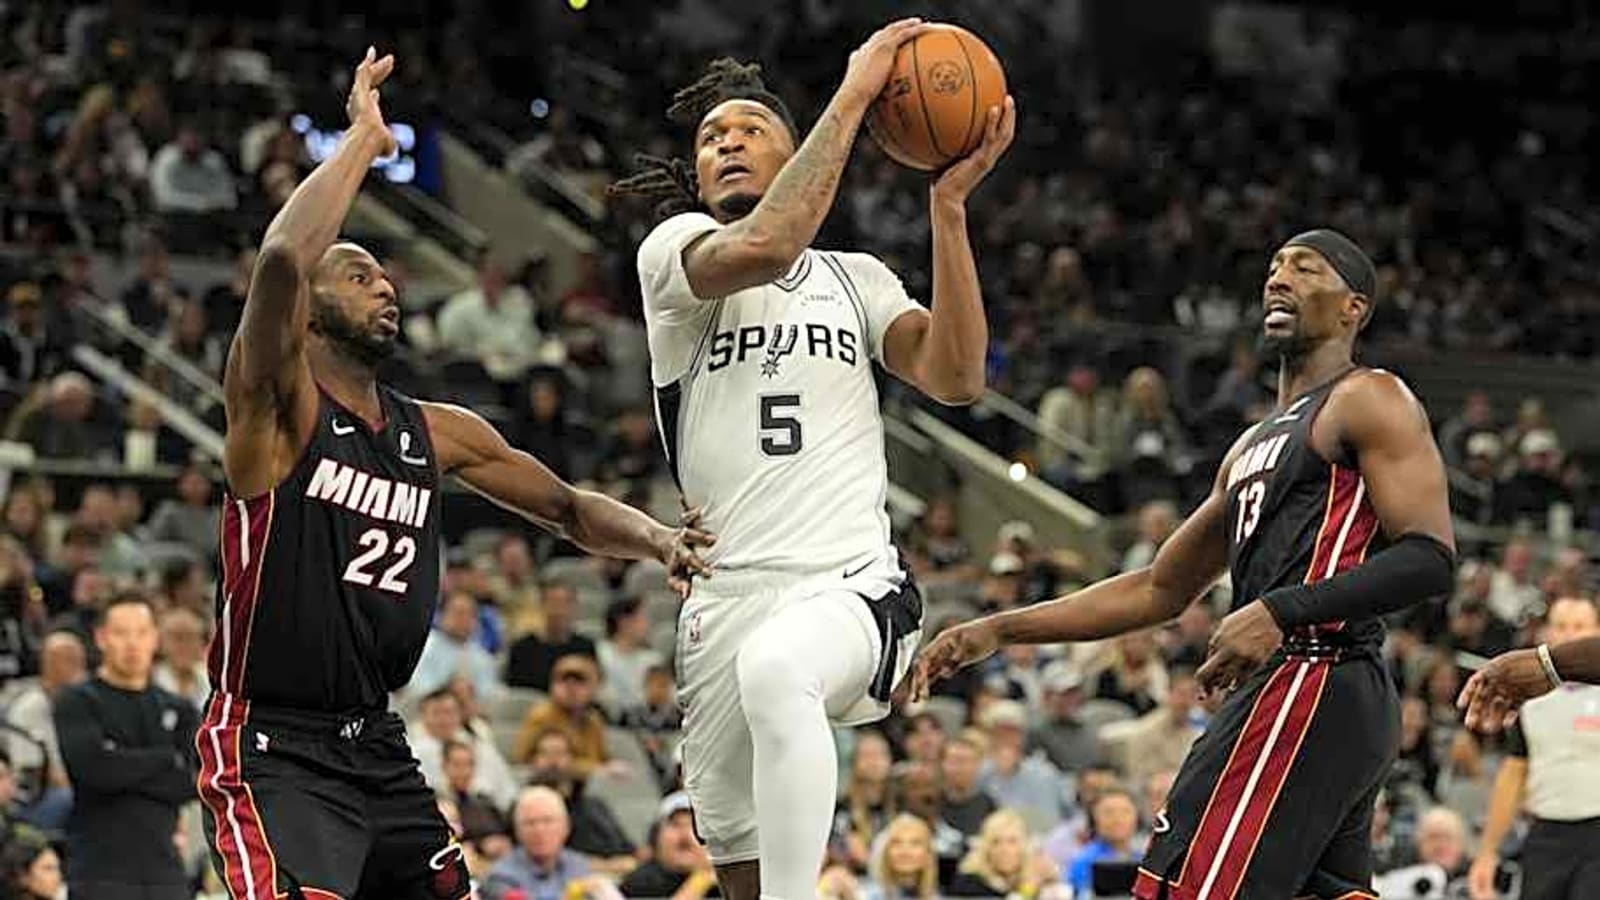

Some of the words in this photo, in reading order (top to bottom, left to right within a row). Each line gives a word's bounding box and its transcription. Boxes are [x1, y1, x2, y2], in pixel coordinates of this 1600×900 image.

[708, 324, 856, 379] SPURS
[760, 394, 802, 456] 5
[306, 457, 431, 528] MIAMI
[1236, 481, 1265, 544] 13
[343, 528, 416, 593] 22
